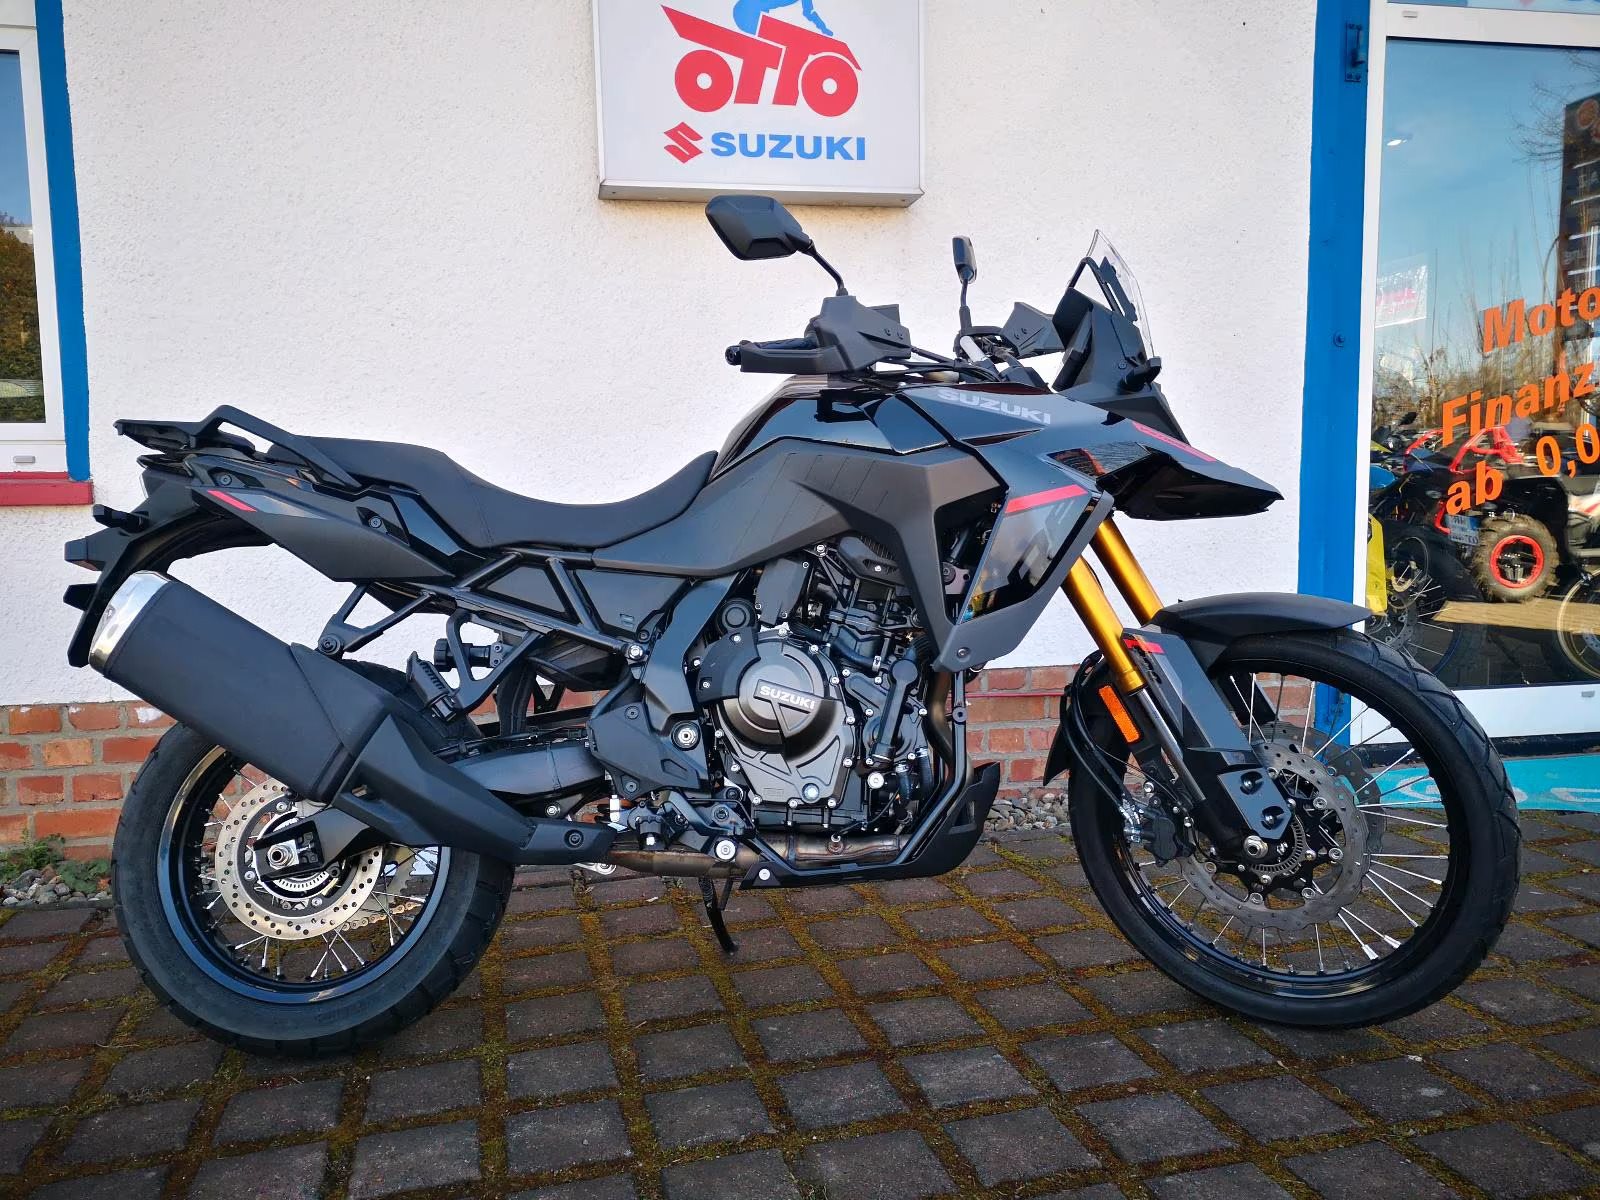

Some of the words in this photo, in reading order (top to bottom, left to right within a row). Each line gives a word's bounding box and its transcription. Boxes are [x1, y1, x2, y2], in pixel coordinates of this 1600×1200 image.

[662, 4, 862, 117] OTTO
[711, 131, 866, 161] SUZUKI
[937, 388, 1051, 425] SUZUKI
[1442, 362, 1596, 447] Finanz
[1446, 460, 1504, 515] ab
[1535, 423, 1600, 479] 0,0
[759, 685, 816, 710] SUZUKI
